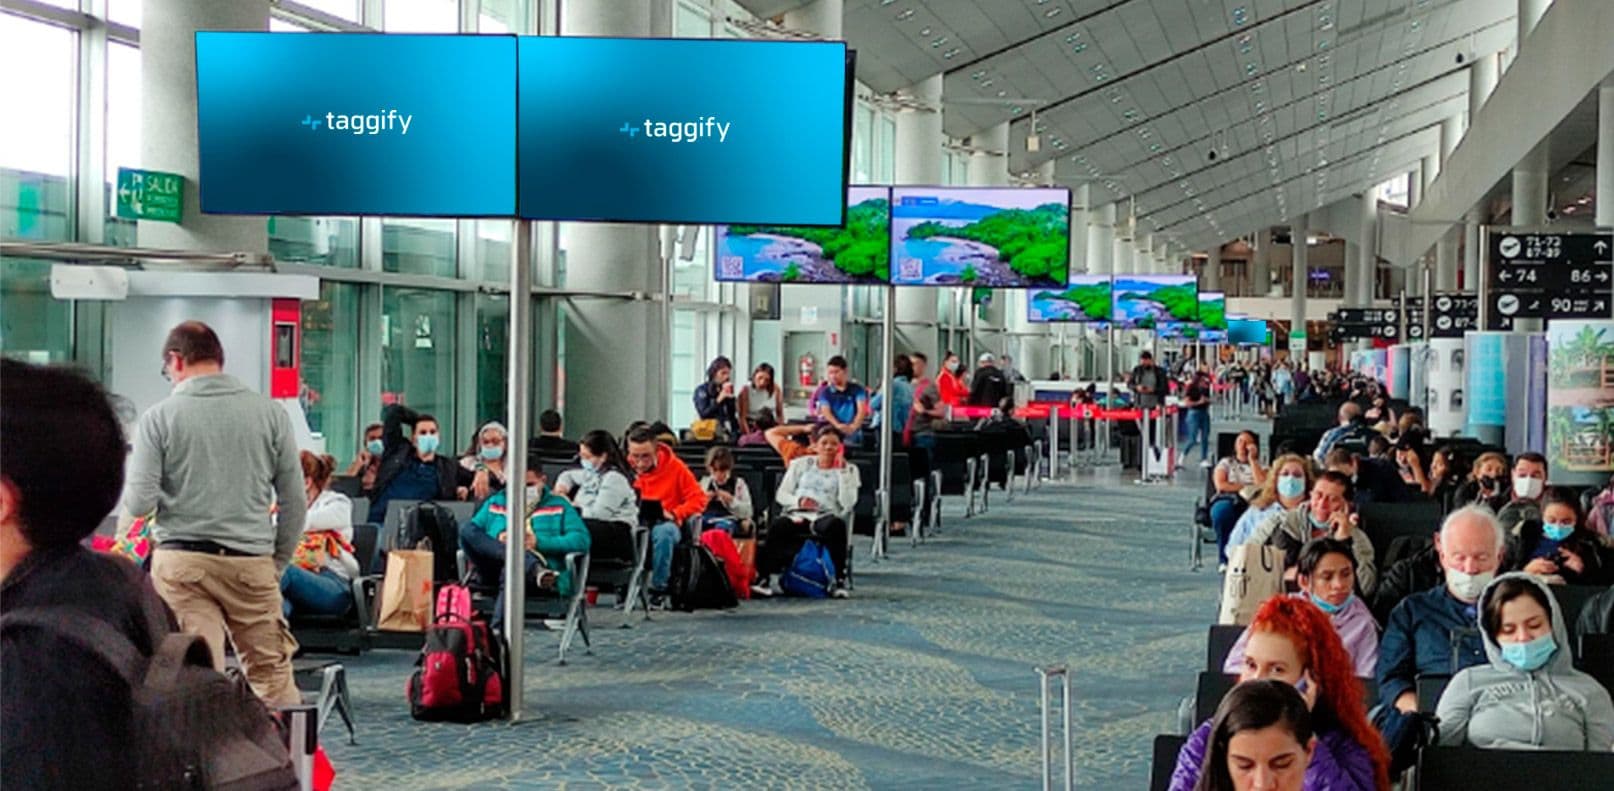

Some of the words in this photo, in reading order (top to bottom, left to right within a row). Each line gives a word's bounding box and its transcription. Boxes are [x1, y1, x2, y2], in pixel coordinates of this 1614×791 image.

[326, 109, 413, 135] taggify
[643, 116, 731, 143] taggify
[1516, 269, 1537, 283] 74
[1570, 269, 1592, 283] 86
[1551, 297, 1572, 313] 90
